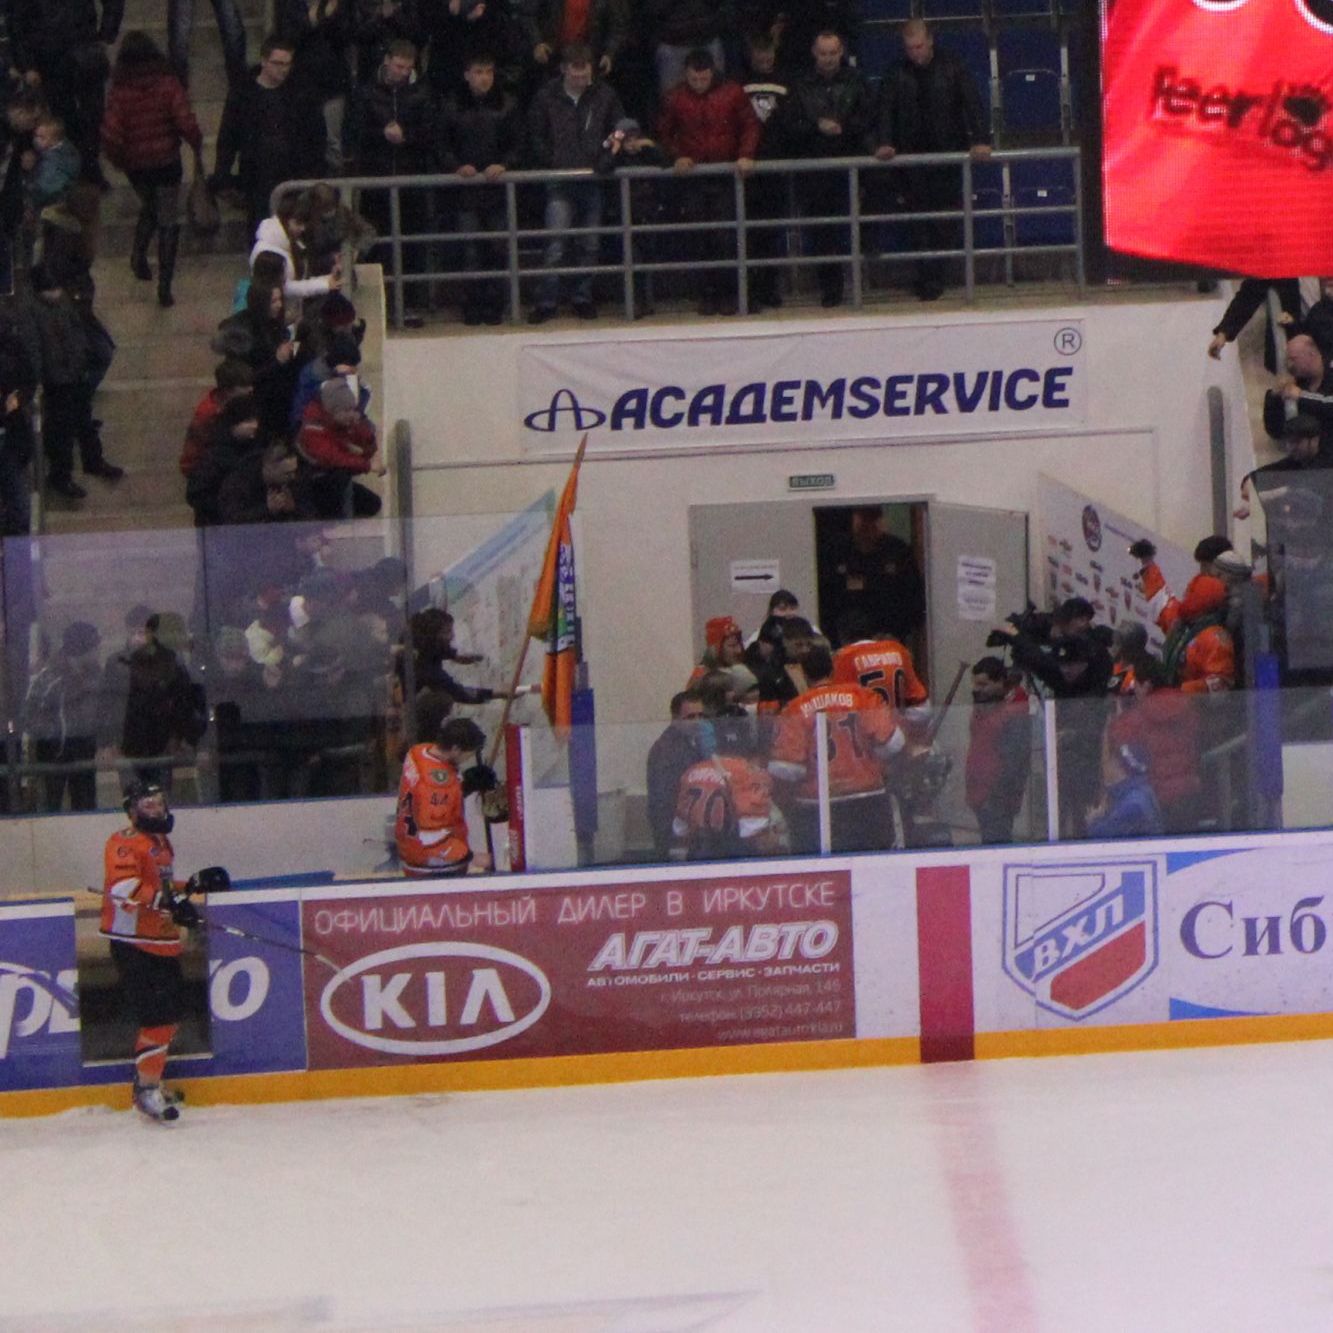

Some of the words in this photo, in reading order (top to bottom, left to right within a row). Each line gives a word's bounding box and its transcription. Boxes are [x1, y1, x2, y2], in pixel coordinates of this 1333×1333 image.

[314, 892, 538, 935] ОФИЦИАЛЬНЫЙ
[556, 891, 647, 927] ДИЛЕР
[667, 891, 683, 914] В
[704, 881, 836, 914] ИРКУТСКЕ
[587, 920, 840, 972] АГАТ-АВТО
[1033, 893, 1124, 978] ВХЛ
[697, 967, 757, 982] СЕРВИС
[763, 962, 841, 977] ЗАПЧАСТИ
[360, 970, 514, 1030] KIA
